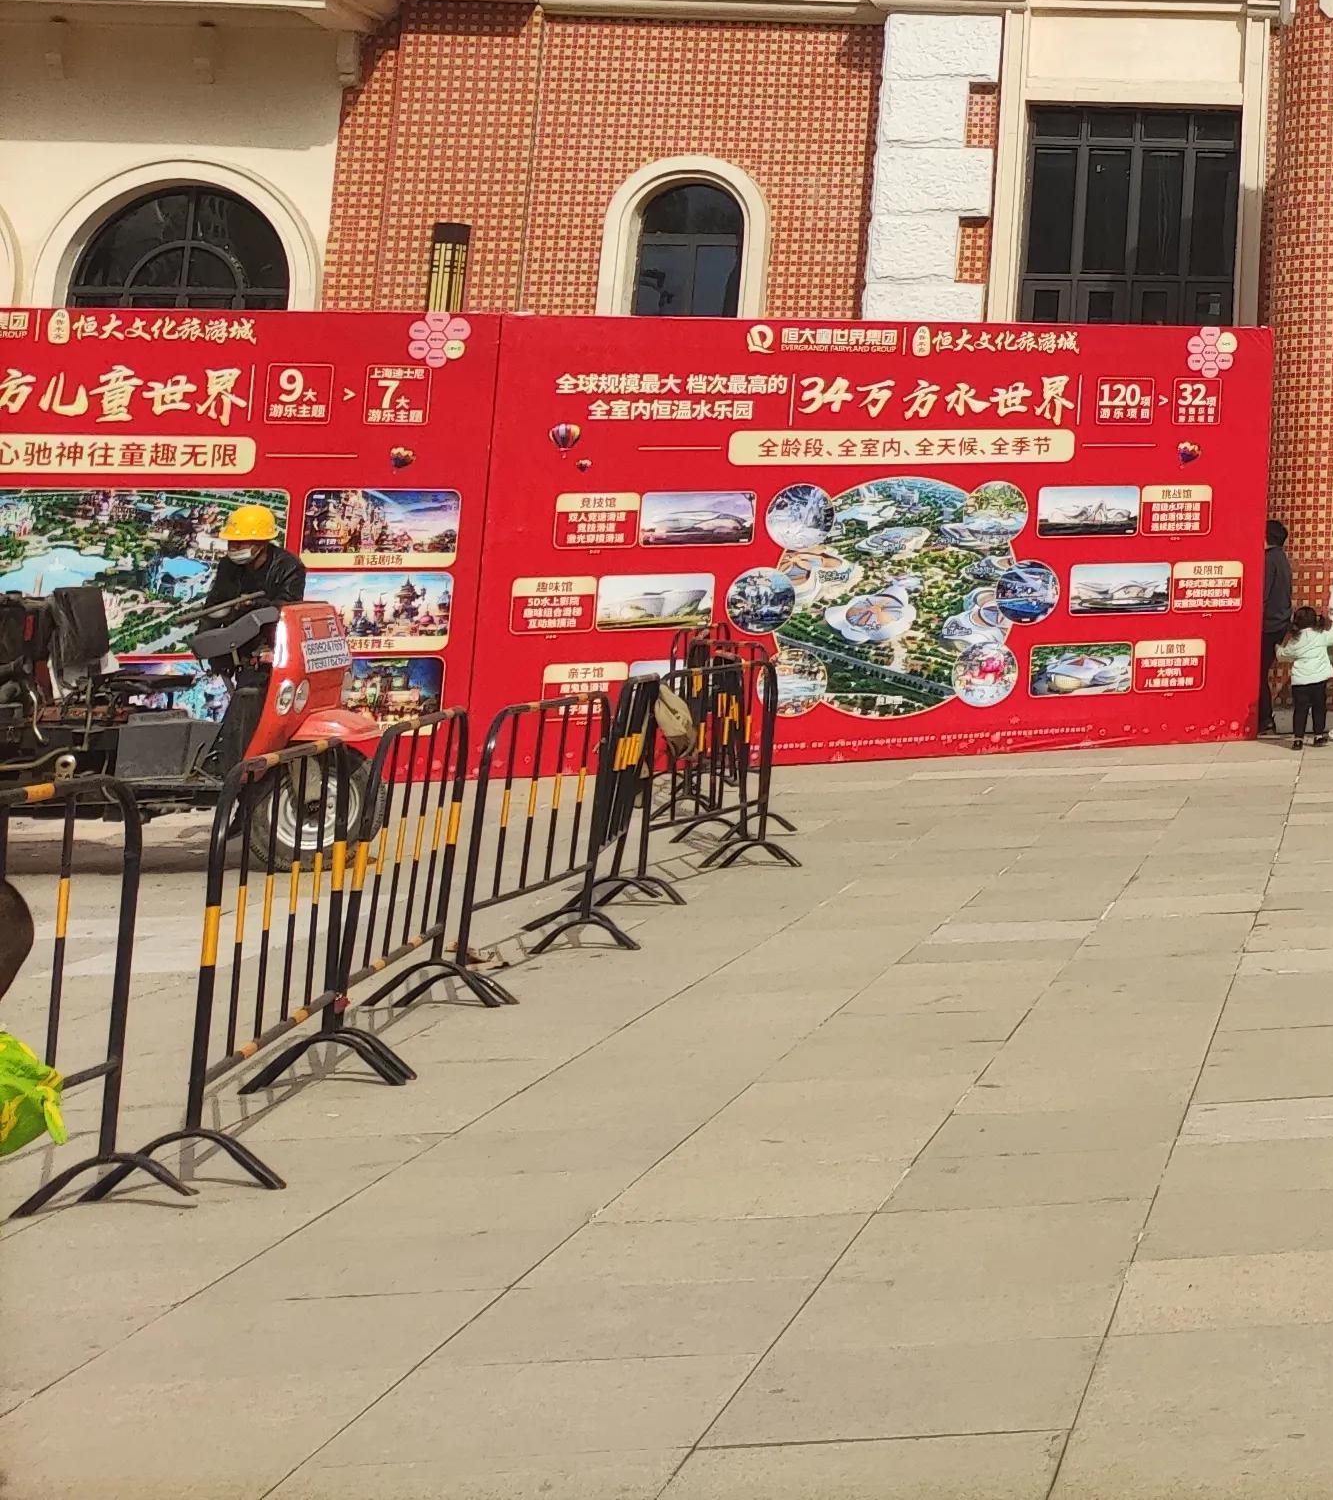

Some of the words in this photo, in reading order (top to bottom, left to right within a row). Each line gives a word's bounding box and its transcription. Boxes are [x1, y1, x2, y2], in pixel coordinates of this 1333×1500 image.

[0, 331, 28, 339] ROUP
[73, 313, 257, 344] 恒大文化旅游城
[932, 330, 1080, 354] 恒大文化旅游城
[369, 368, 425, 379] 上海迪士尼
[555, 373, 682, 395] 全球规模最大
[686, 373, 788, 395] 档次最高的
[0, 365, 248, 427] 方儿童世界
[798, 375, 1076, 425] 34万方水世界
[269, 404, 326, 418] 游乐主题
[367, 409, 424, 423] 游乐主题
[587, 400, 754, 421] 全室内恒温水乐园
[0, 442, 238, 467] 心驰神往童趣无限
